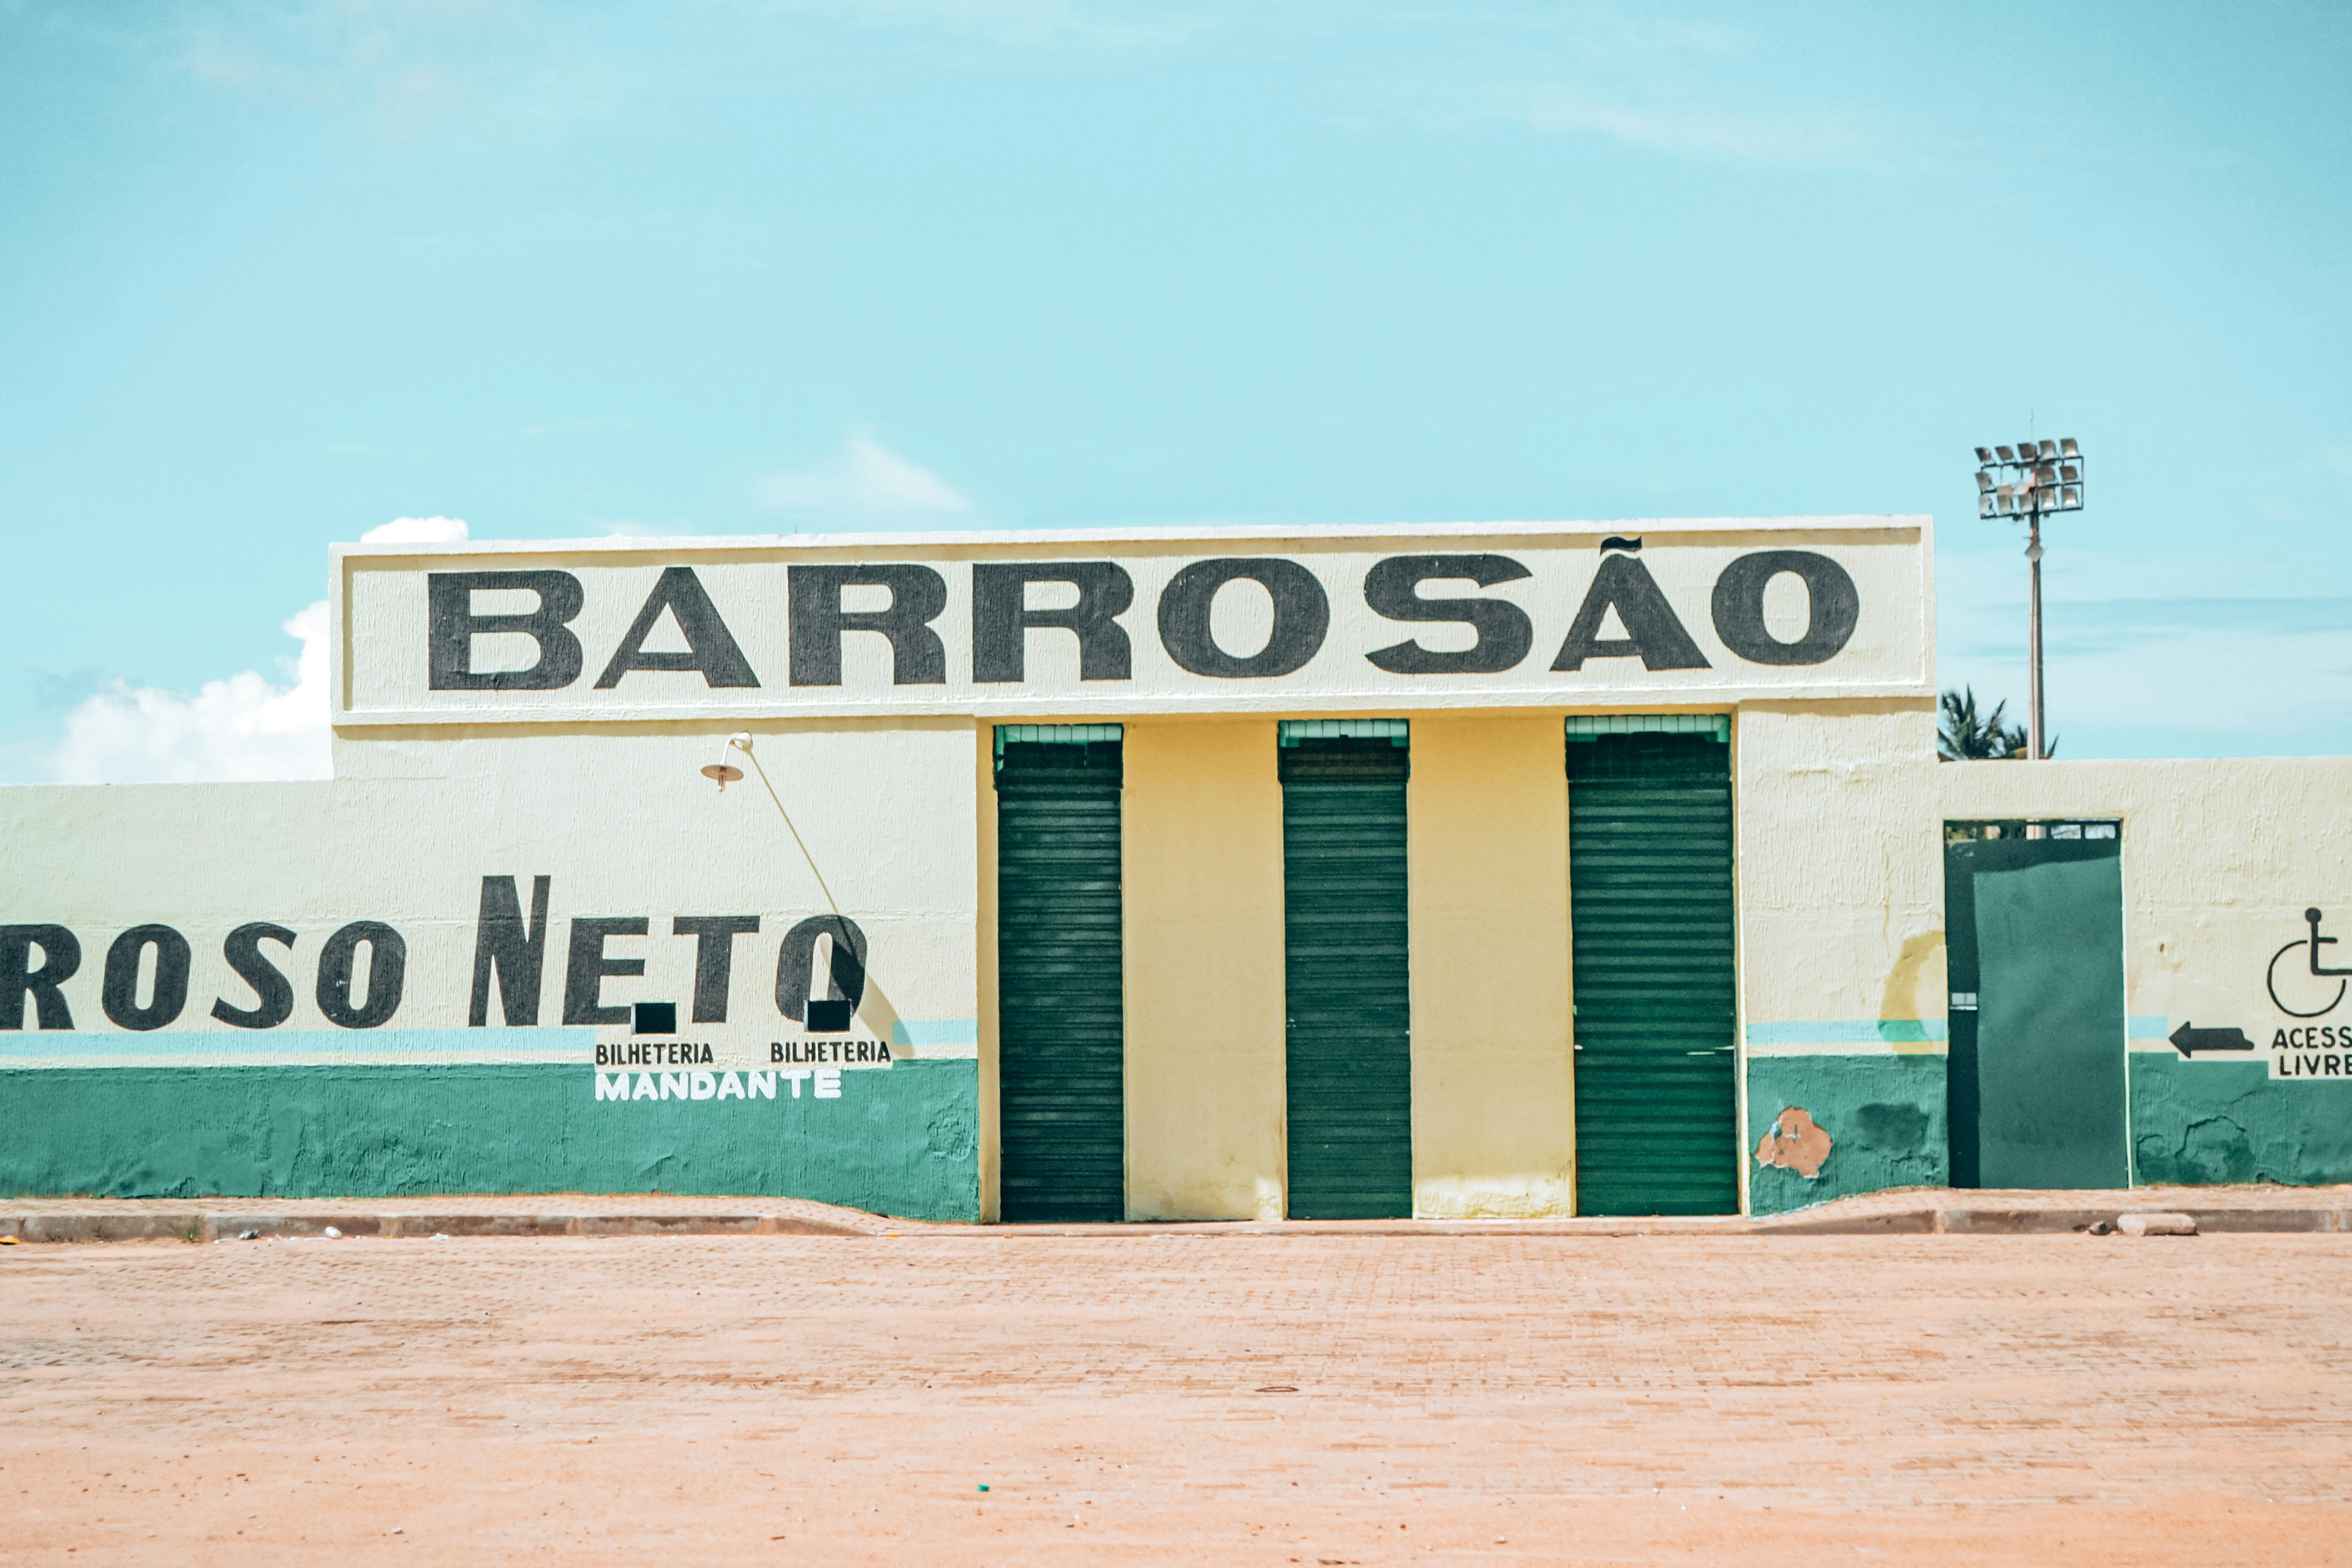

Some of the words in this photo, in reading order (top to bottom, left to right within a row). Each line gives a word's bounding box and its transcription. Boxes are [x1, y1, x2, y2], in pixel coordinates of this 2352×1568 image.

[428, 535, 1859, 691] BARROSÃO
[0, 921, 406, 1030] ROSO
[468, 875, 868, 1028] NETO
[595, 1043, 713, 1066] BILHETERIA
[770, 1041, 891, 1063] BILHETERIA
[595, 1068, 842, 1101] MANDANTE
